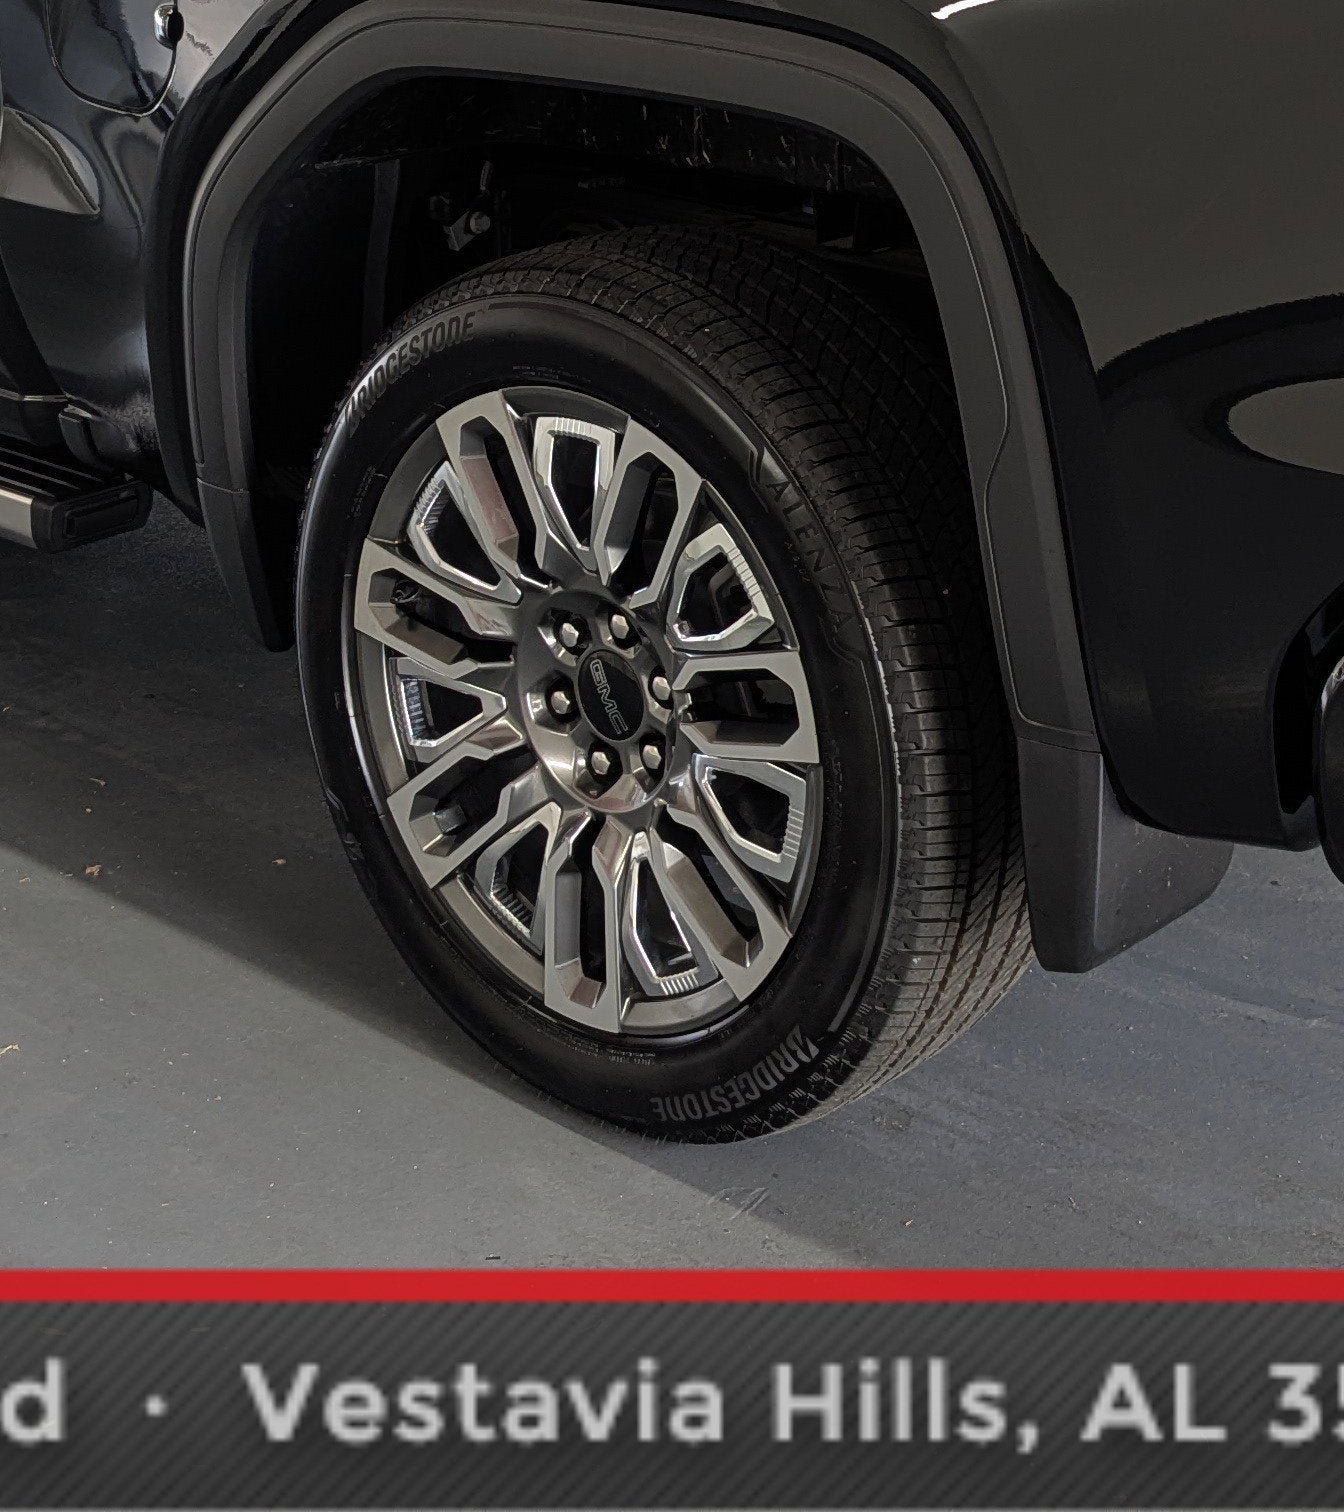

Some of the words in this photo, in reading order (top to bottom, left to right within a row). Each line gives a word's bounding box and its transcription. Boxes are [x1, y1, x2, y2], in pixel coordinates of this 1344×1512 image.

[344, 311, 476, 438] BRIDGESTONE
[589, 658, 629, 735] GMC
[648, 1024, 820, 1122] BRIDGESTONE
